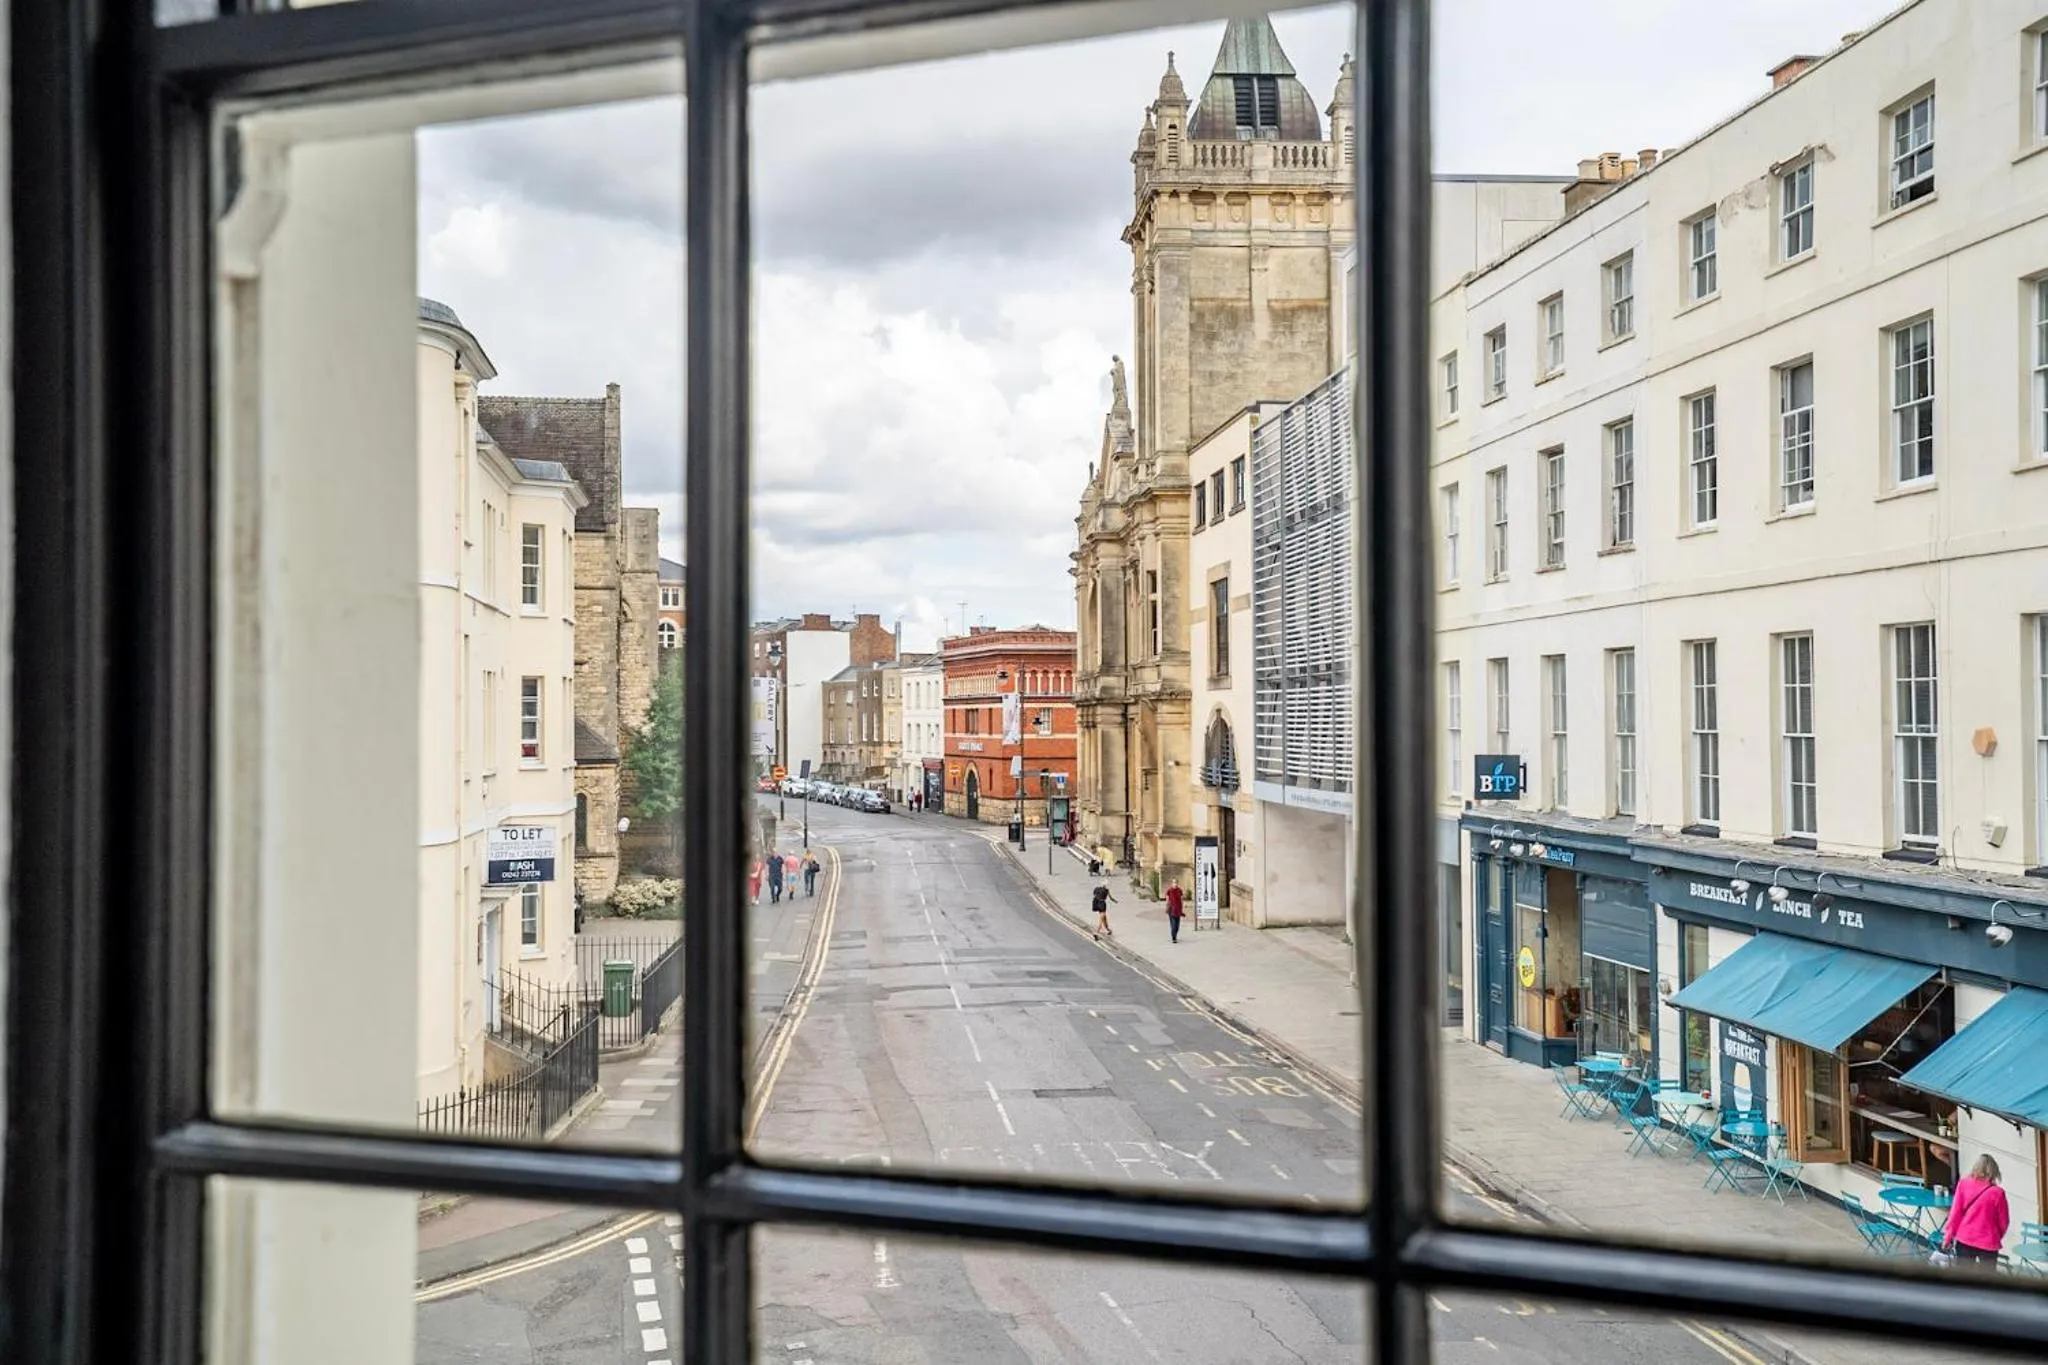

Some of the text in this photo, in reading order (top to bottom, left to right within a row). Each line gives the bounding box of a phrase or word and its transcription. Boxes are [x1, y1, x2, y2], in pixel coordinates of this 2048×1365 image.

[1480, 774, 1516, 793] BTP
[502, 828, 543, 841] TO LET
[1838, 909, 1864, 929] TEA
[1197, 1076, 1309, 1097] BUS
